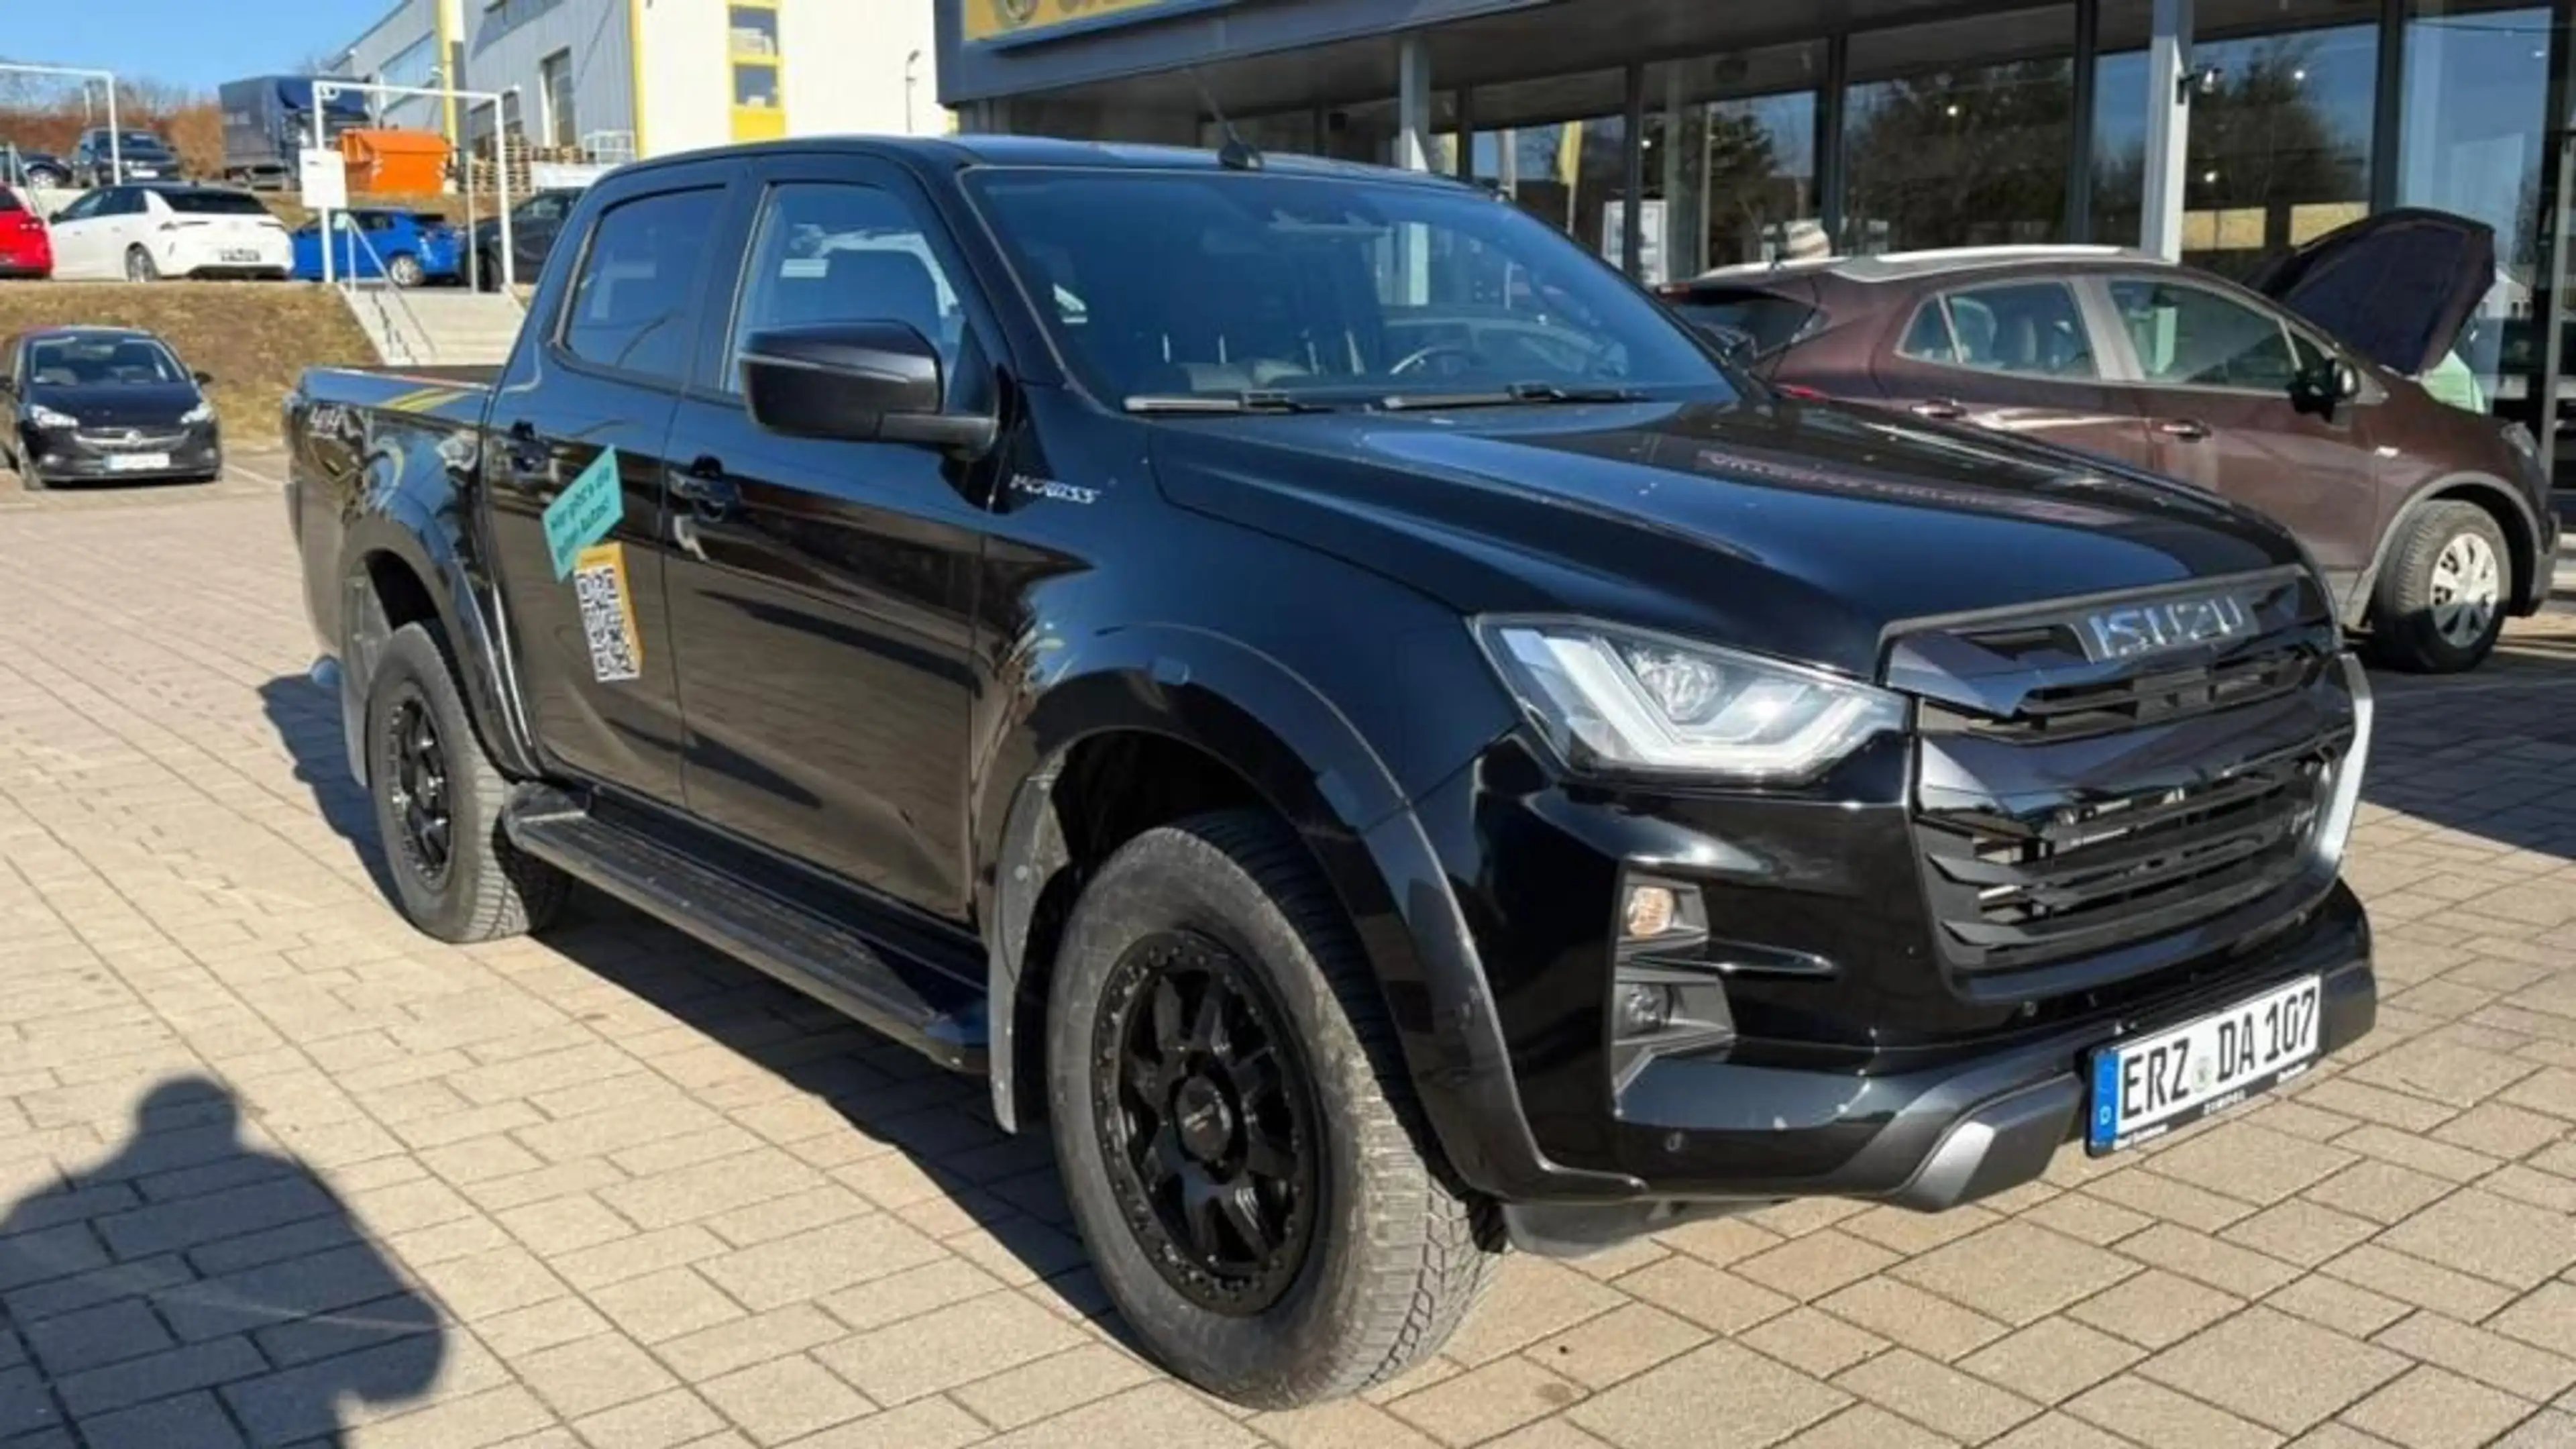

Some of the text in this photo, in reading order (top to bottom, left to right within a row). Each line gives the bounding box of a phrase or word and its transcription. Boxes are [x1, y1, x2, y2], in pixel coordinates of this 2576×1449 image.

[2088, 595, 2244, 659] ISUZU
[2121, 986, 2316, 1120] ERZ DA 107
